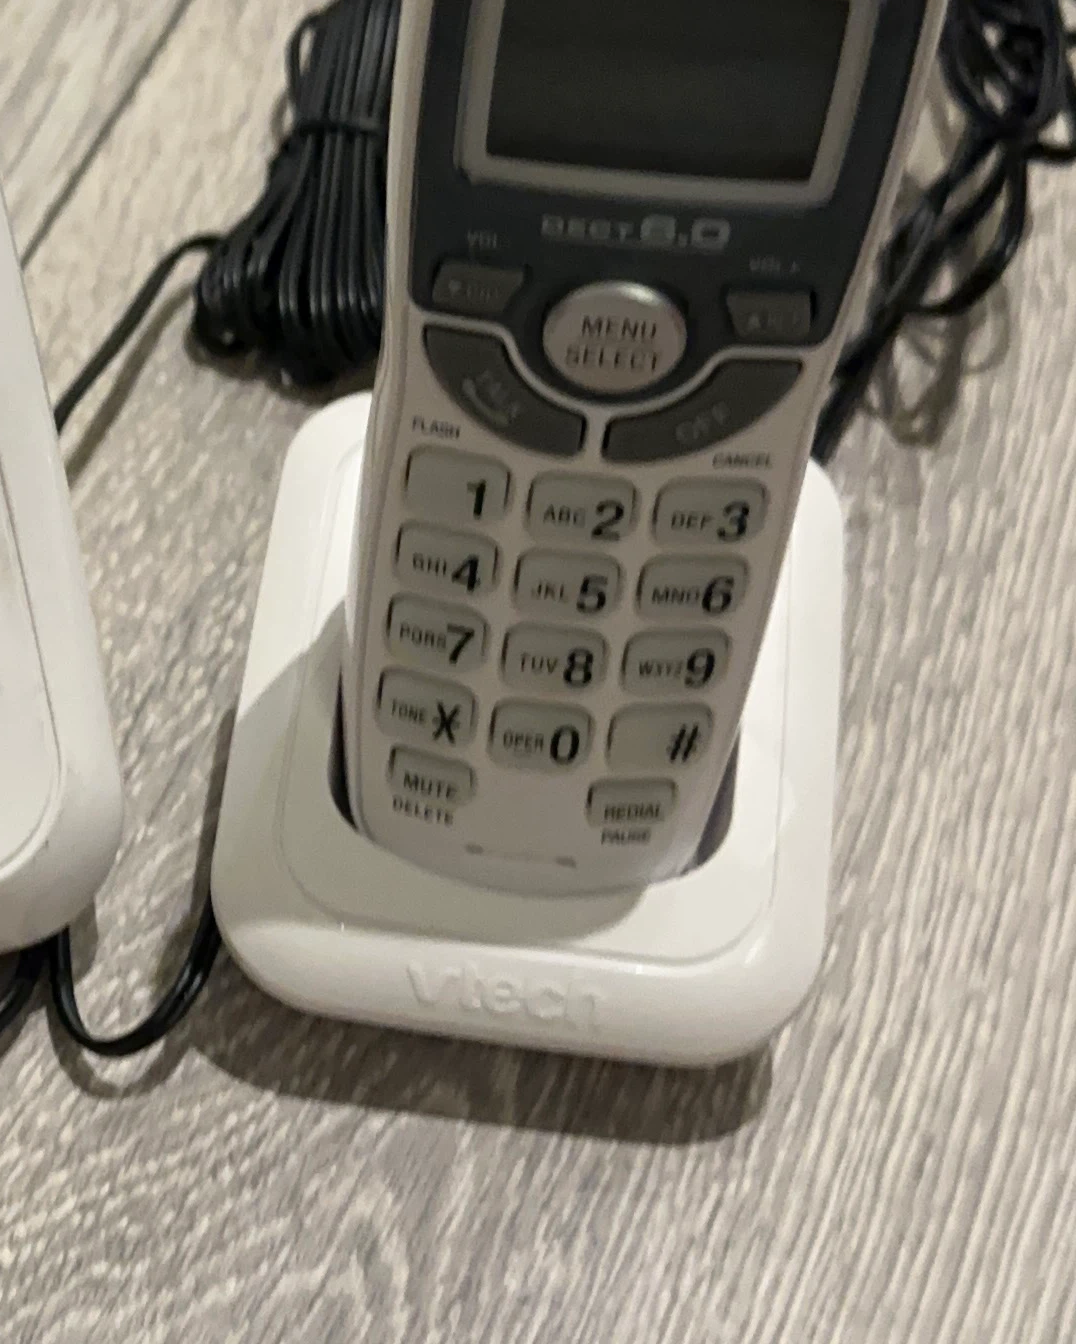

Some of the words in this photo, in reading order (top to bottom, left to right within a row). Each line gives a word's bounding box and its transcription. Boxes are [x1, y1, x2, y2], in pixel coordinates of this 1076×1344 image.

[580, 315, 658, 341] MENU
[565, 346, 664, 373] SELECT
[466, 480, 488, 520] 1
[590, 500, 625, 542] 2
[716, 501, 751, 542] 3
[451, 554, 481, 594] 4
[576, 575, 609, 615] 5
[701, 576, 735, 615] 6
[446, 624, 476, 665] 7
[563, 647, 594, 688] 8
[683, 648, 716, 690] 9
[549, 724, 580, 766] 0
[402, 773, 458, 800] MUTE
[392, 796, 453, 826] DELETE
